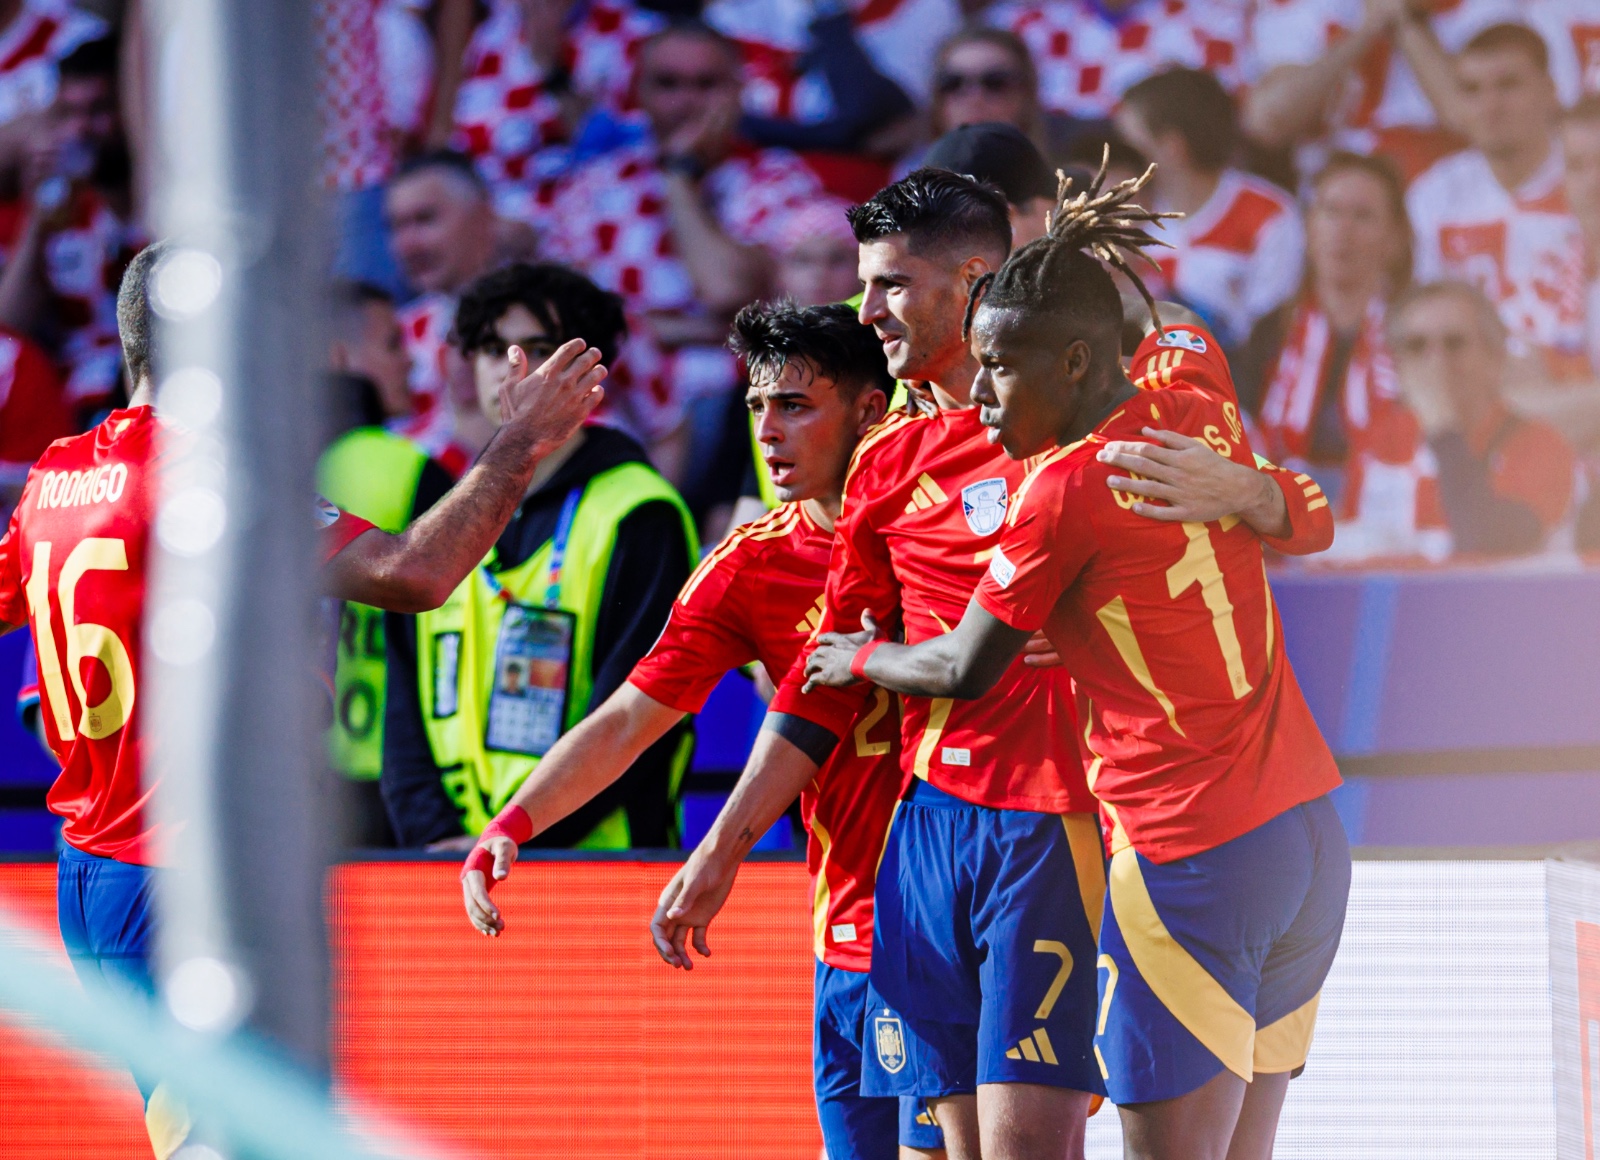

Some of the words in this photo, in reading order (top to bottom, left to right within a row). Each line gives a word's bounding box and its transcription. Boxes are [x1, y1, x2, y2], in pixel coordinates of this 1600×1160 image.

[37, 462, 128, 510] RODRIGO
[25, 537, 136, 742] 16
[1033, 939, 1074, 1019] 7
